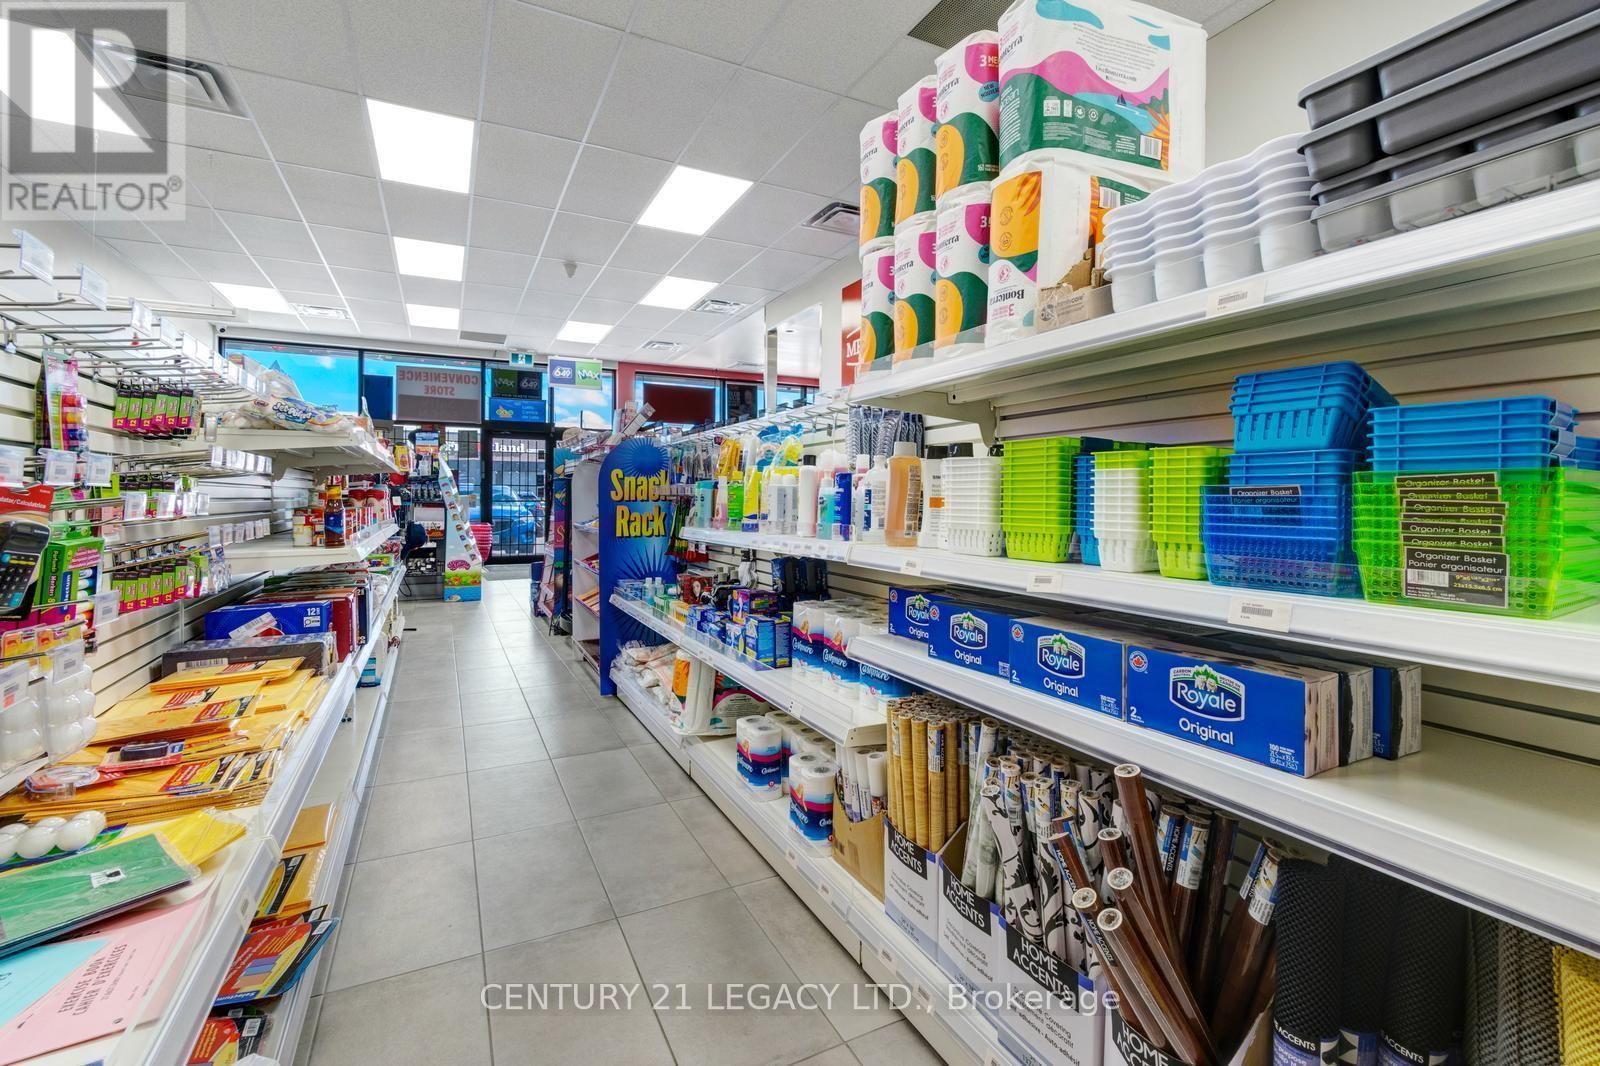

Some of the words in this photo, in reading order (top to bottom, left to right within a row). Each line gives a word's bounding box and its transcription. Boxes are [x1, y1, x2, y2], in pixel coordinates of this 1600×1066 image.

[979, 55, 987, 67] 3
[1453, 477, 1485, 485] Basket
[1413, 504, 1458, 513] Organizer
[1463, 505, 1494, 513] Basket
[616, 505, 667, 538] Rack
[1408, 560, 1437, 568] Panier
[1441, 563, 1504, 574] organisateur
[1415, 551, 1460, 561] Organizer
[1464, 554, 1497, 564] Basket
[307, 607, 316, 615] 12
[909, 626, 929, 639] Origina
[953, 625, 983, 643] Royale
[823, 649, 847, 668] Cashmere
[954, 649, 982, 665] Original
[1042, 649, 1080, 671] Royale
[1043, 677, 1079, 697] Original
[1177, 682, 1236, 712] Royale
[1130, 706, 1137, 717] 2
[1179, 717, 1234, 745] Original
[895, 830, 914, 855] HOME
[891, 840, 922, 874] ACCENTS
[950, 875, 974, 906] HOME
[1064, 869, 1078, 892] ACCEN
[946, 886, 985, 928] ACCENTS
[1021, 937, 1058, 975] HOME
[1013, 948, 1071, 1001] ACCENTS
[1121, 1021, 1168, 1066] HOME
[1278, 1026, 1316, 1051] ACCENTS
[1385, 1035, 1425, 1064] ACCENTS
